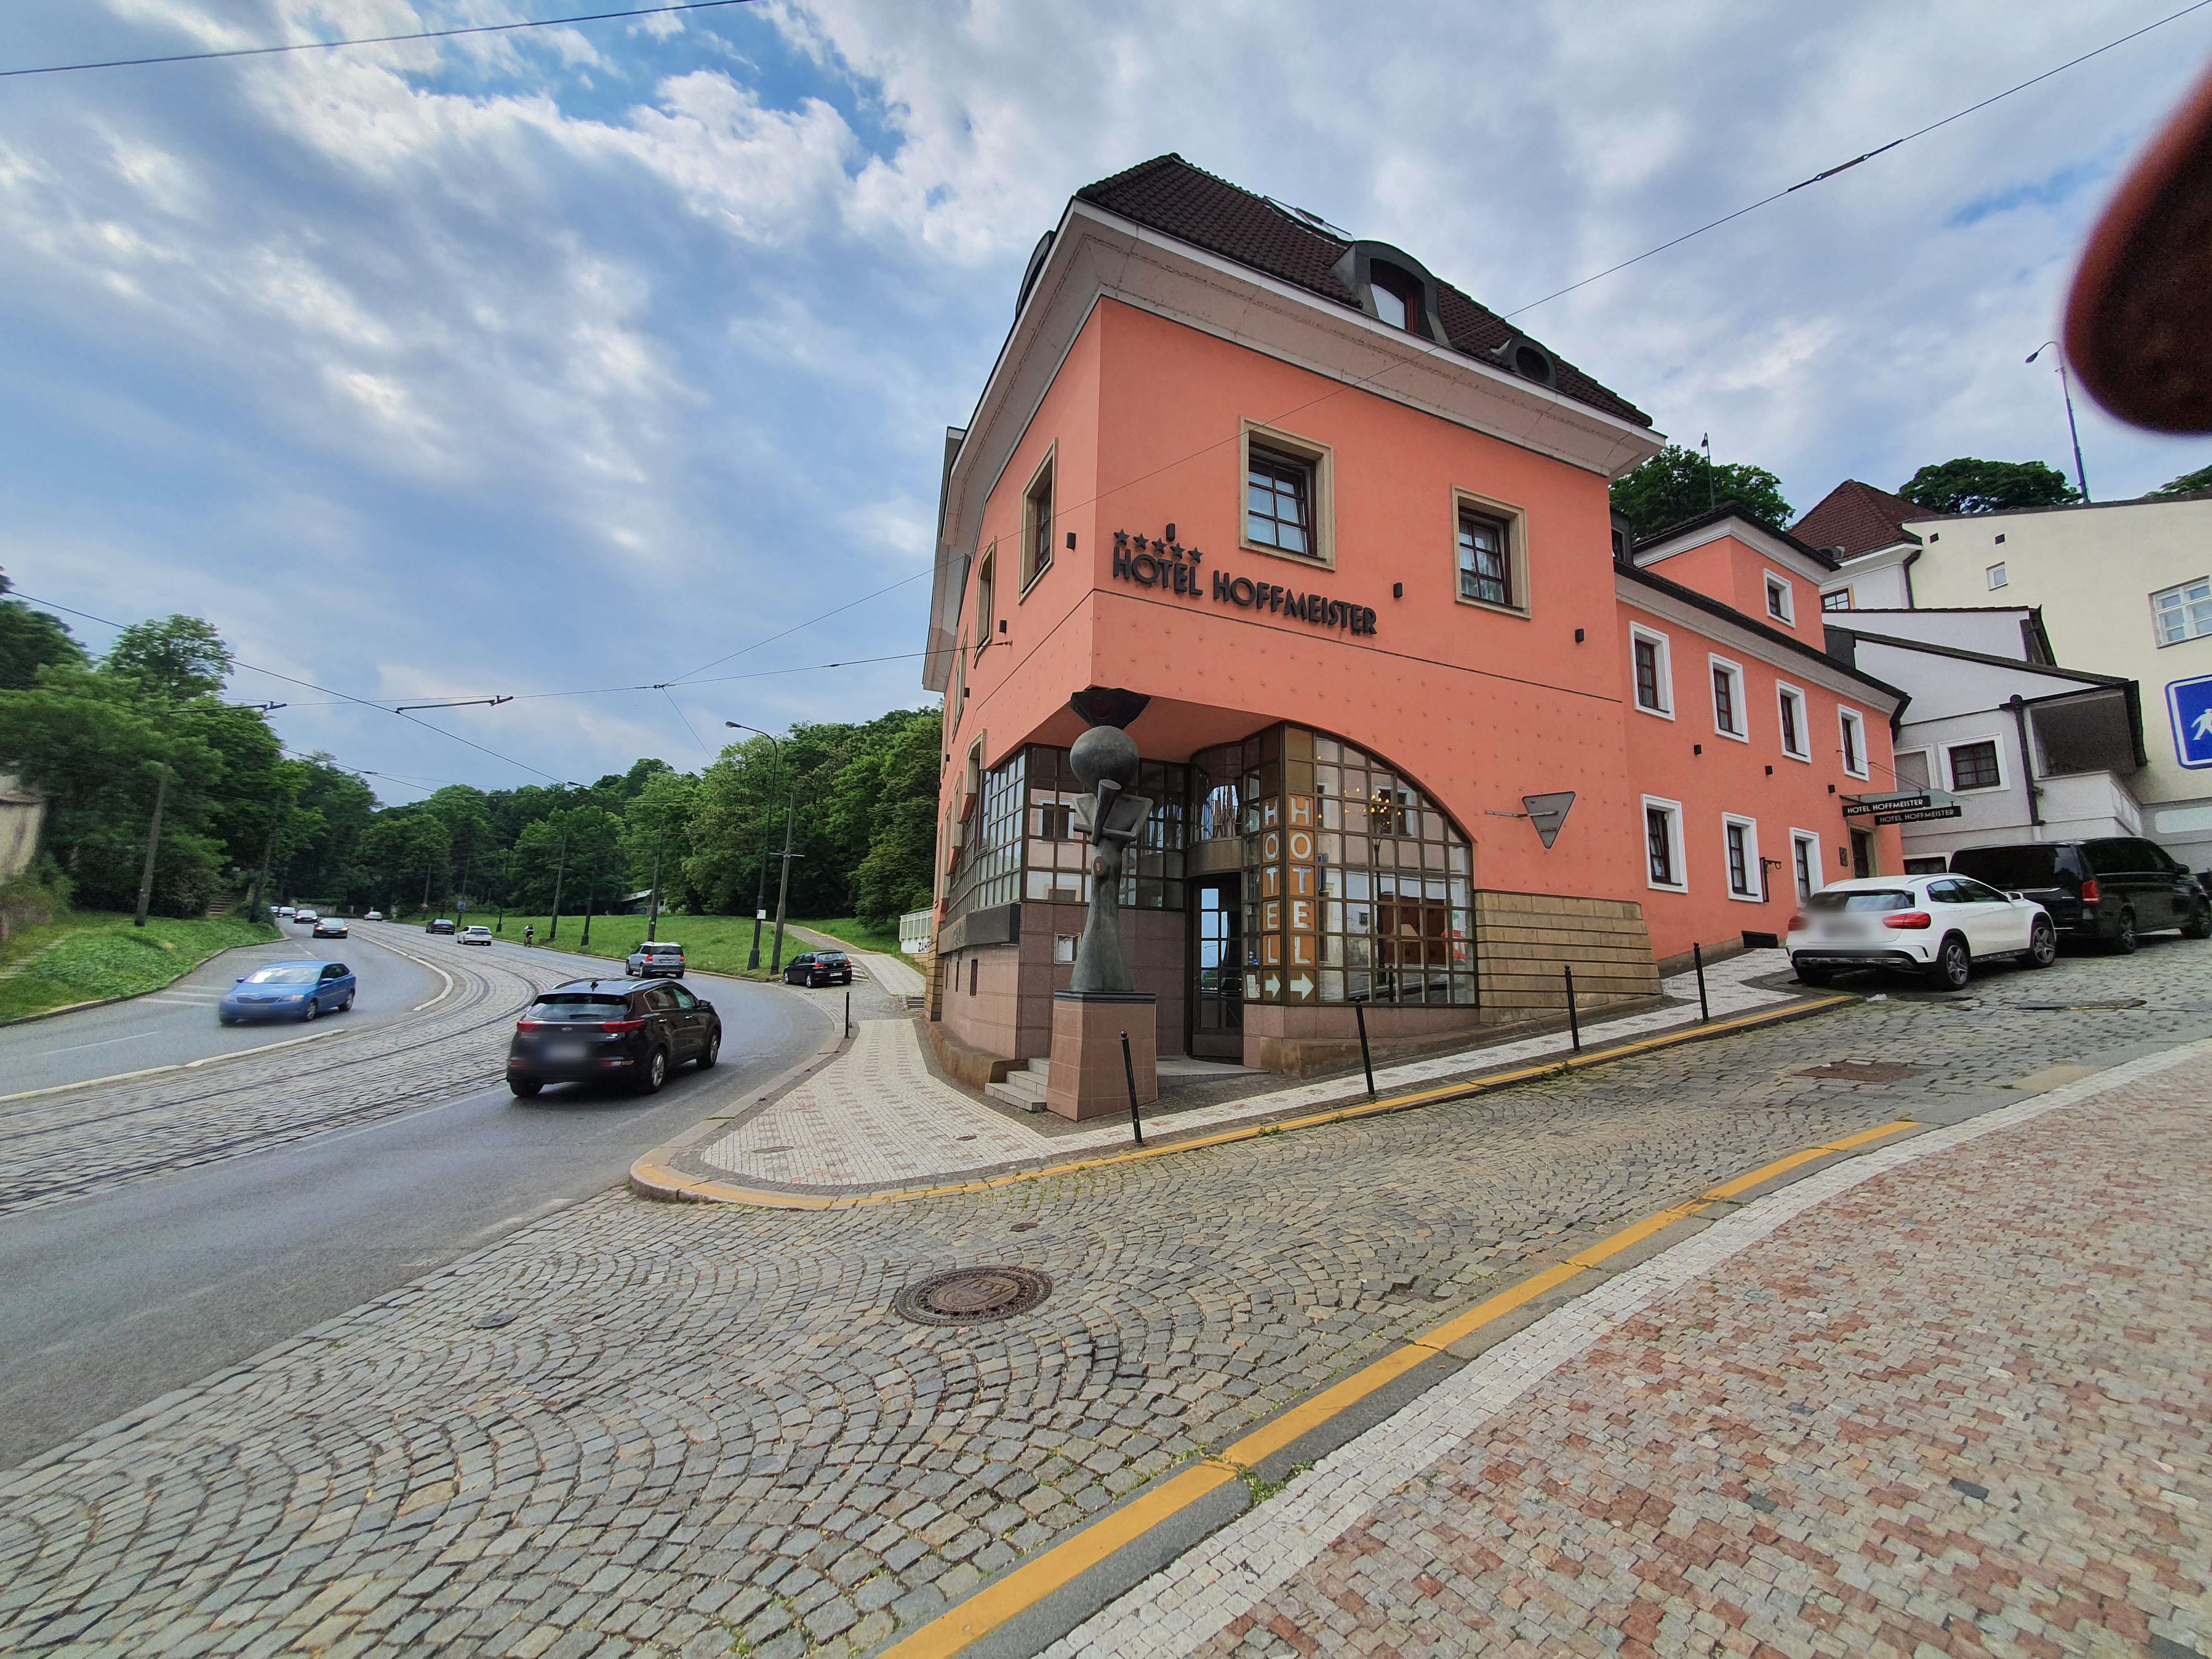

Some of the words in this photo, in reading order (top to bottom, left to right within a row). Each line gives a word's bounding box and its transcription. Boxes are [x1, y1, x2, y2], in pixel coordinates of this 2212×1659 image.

[1113, 546, 1203, 596] HOTEL
[1213, 570, 1377, 635] HOFFMEISTER
[1873, 799, 1923, 811] HOFFMEISTER
[1905, 809, 1954, 820] HOFFMEISTER
[1265, 798, 1279, 964] HOTEL
[1290, 796, 1312, 964] HOTEL
